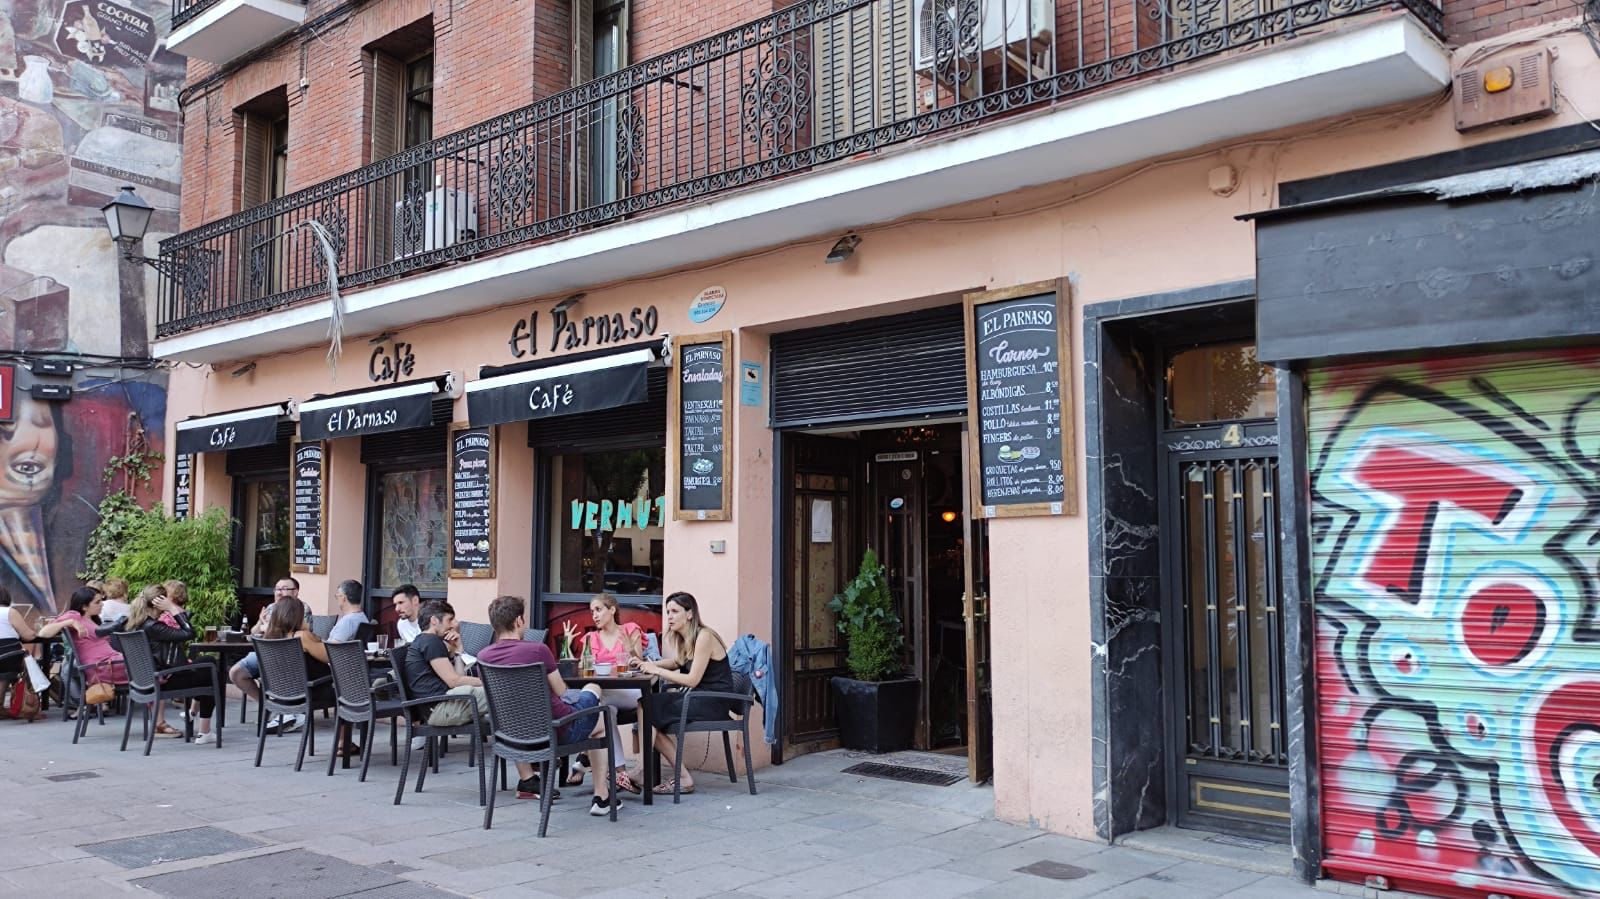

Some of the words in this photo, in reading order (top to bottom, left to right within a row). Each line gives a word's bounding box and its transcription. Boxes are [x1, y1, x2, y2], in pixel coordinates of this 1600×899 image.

[98, 2, 149, 32] COCKTAIL
[508, 310, 538, 358] El
[550, 305, 659, 352] Parnaso
[984, 317, 1001, 336] EL
[1004, 310, 1052, 328] PARNASO
[368, 342, 416, 382] Café
[686, 354, 694, 364] EL
[694, 350, 720, 361] PARNASO
[989, 340, 1050, 364] Carnes
[682, 368, 722, 382] Ensaladas
[980, 364, 1036, 381] HAMBURGUESA
[529, 383, 574, 412] Café
[982, 384, 1026, 400] ALBÓNDIGAS
[327, 410, 342, 432] El
[346, 408, 396, 430] Parnaso
[982, 404, 1020, 416] COSTILLAS
[984, 418, 1006, 430] POLLO
[210, 428, 236, 446] Café
[983, 432, 1012, 444] FINGERS
[1224, 425, 1240, 448] 4
[571, 496, 665, 532] VERMUT
